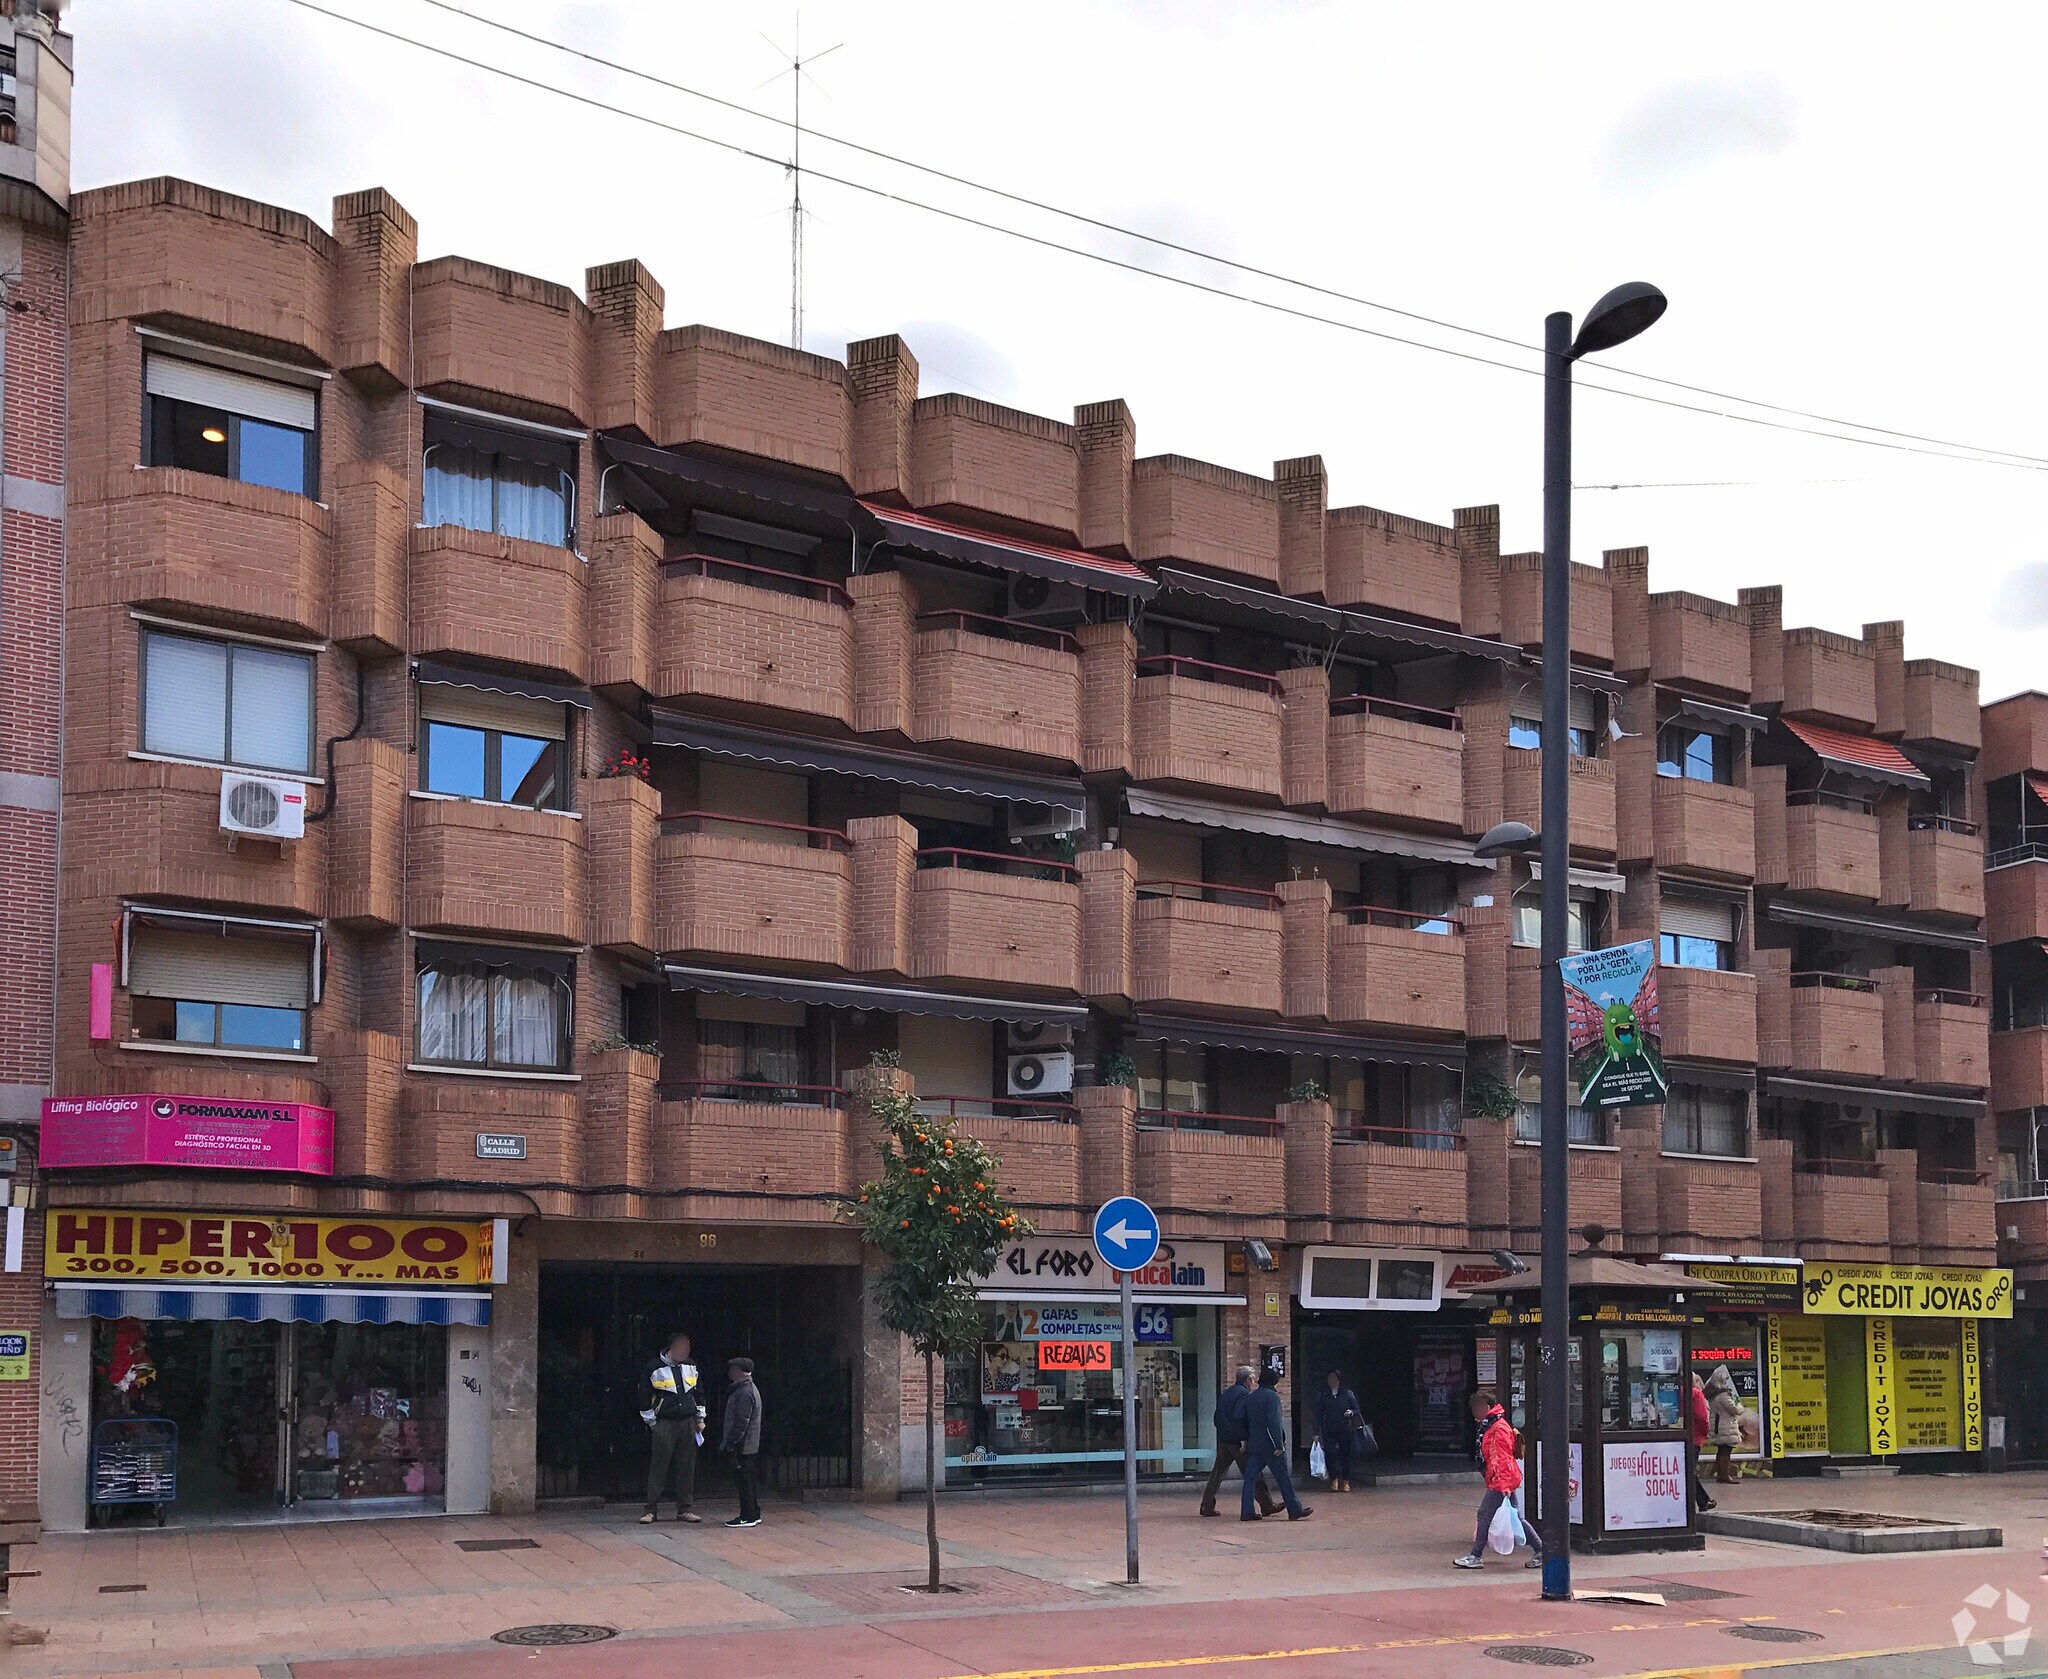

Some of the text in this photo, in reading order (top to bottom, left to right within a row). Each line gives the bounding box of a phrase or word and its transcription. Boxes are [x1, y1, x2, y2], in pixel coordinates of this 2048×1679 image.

[1583, 949, 1628, 965] UNA SENDA
[1577, 963, 1594, 975] POR
[1595, 962, 1606, 972] LA
[1577, 965, 1642, 985] Y POR RECICLAR
[51, 1099, 138, 1114] Lifting Biológico
[178, 1104, 269, 1120] FORMAXAM
[174, 1140, 224, 1149] DIAGNÓSTICO
[225, 1142, 250, 1150] FACIAL
[184, 1133, 262, 1143] ESTÉTICO PROFESIONAL
[487, 1138, 516, 1146] CALLE
[483, 1147, 520, 1155] MADRID
[700, 1233, 717, 1248] 96
[66, 1257, 146, 1275] 300,
[159, 1259, 235, 1277] 500,
[248, 1261, 324, 1277] 1000
[395, 1265, 460, 1280] MAS
[1006, 1248, 1095, 1277] EL FORO
[1838, 1269, 1982, 1283] CREDIT JOYAS CREDIT JOYAS CREDIT JOYAS
[1838, 1283, 1982, 1311] CREDIT JOYAS
[1986, 1276, 2010, 1311] ORO
[1022, 1308, 1040, 1335] 2
[1041, 1308, 1078, 1321] GAFAS
[1519, 1313, 1530, 1323] 90
[1625, 1313, 1645, 1321] BOTES
[1646, 1313, 1686, 1322] MILLONARIOS
[1041, 1322, 1103, 1336] COMPLETAS
[1103, 1323, 1111, 1331] DE
[1043, 1344, 1107, 1366] REBAJAS
[1900, 1350, 1949, 1360] CREDIT JOYAS
[1769, 1317, 1782, 1453] CREDIT JOYAS
[1872, 1320, 1891, 1450] CREDIT JOYAS
[1964, 1320, 1979, 1446] CREDIT JOYAS
[961, 1452, 997, 1464] opticalain
[1610, 1457, 1636, 1470] JUEGOS
[1637, 1451, 1680, 1476] HUELLA
[1646, 1479, 1680, 1501] SOCIAL
